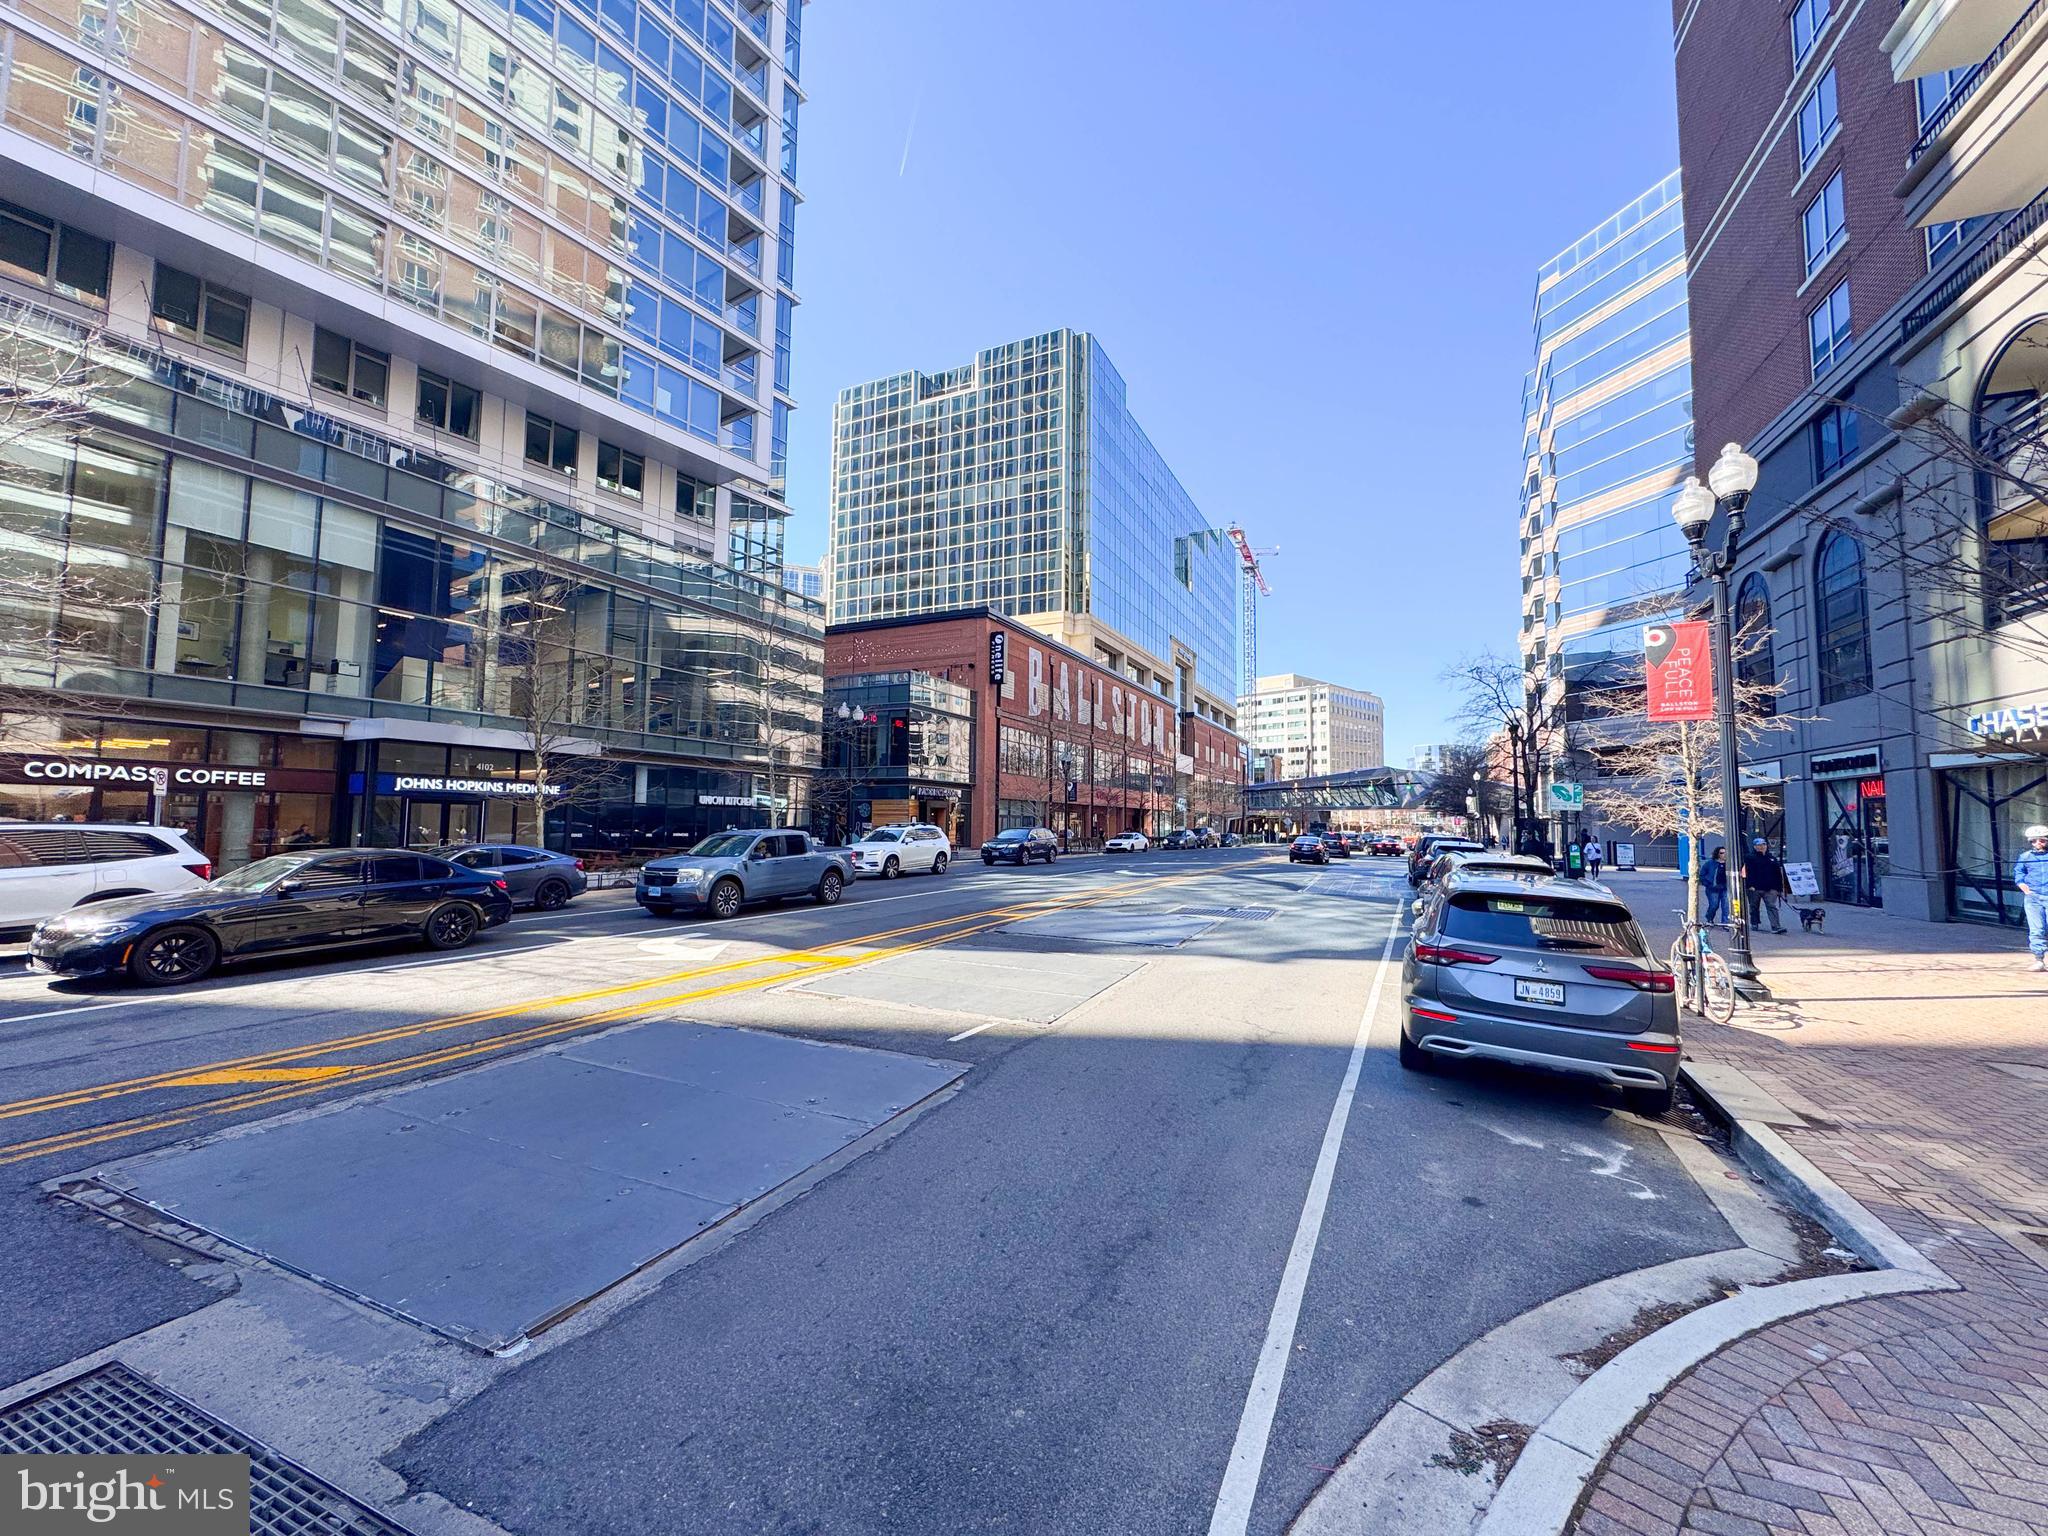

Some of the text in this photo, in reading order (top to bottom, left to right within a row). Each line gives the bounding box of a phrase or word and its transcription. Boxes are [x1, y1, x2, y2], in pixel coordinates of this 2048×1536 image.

[1664, 660, 1679, 699] FULL
[1678, 648, 1692, 698] PEACE
[1028, 646, 1165, 753] BALLSTON
[23, 761, 266, 786] COMPASS COFFEE
[476, 763, 494, 771] 4102
[394, 777, 443, 791] JOHNS
[446, 779, 503, 793] HOPKINS
[699, 795, 724, 805] UNION
